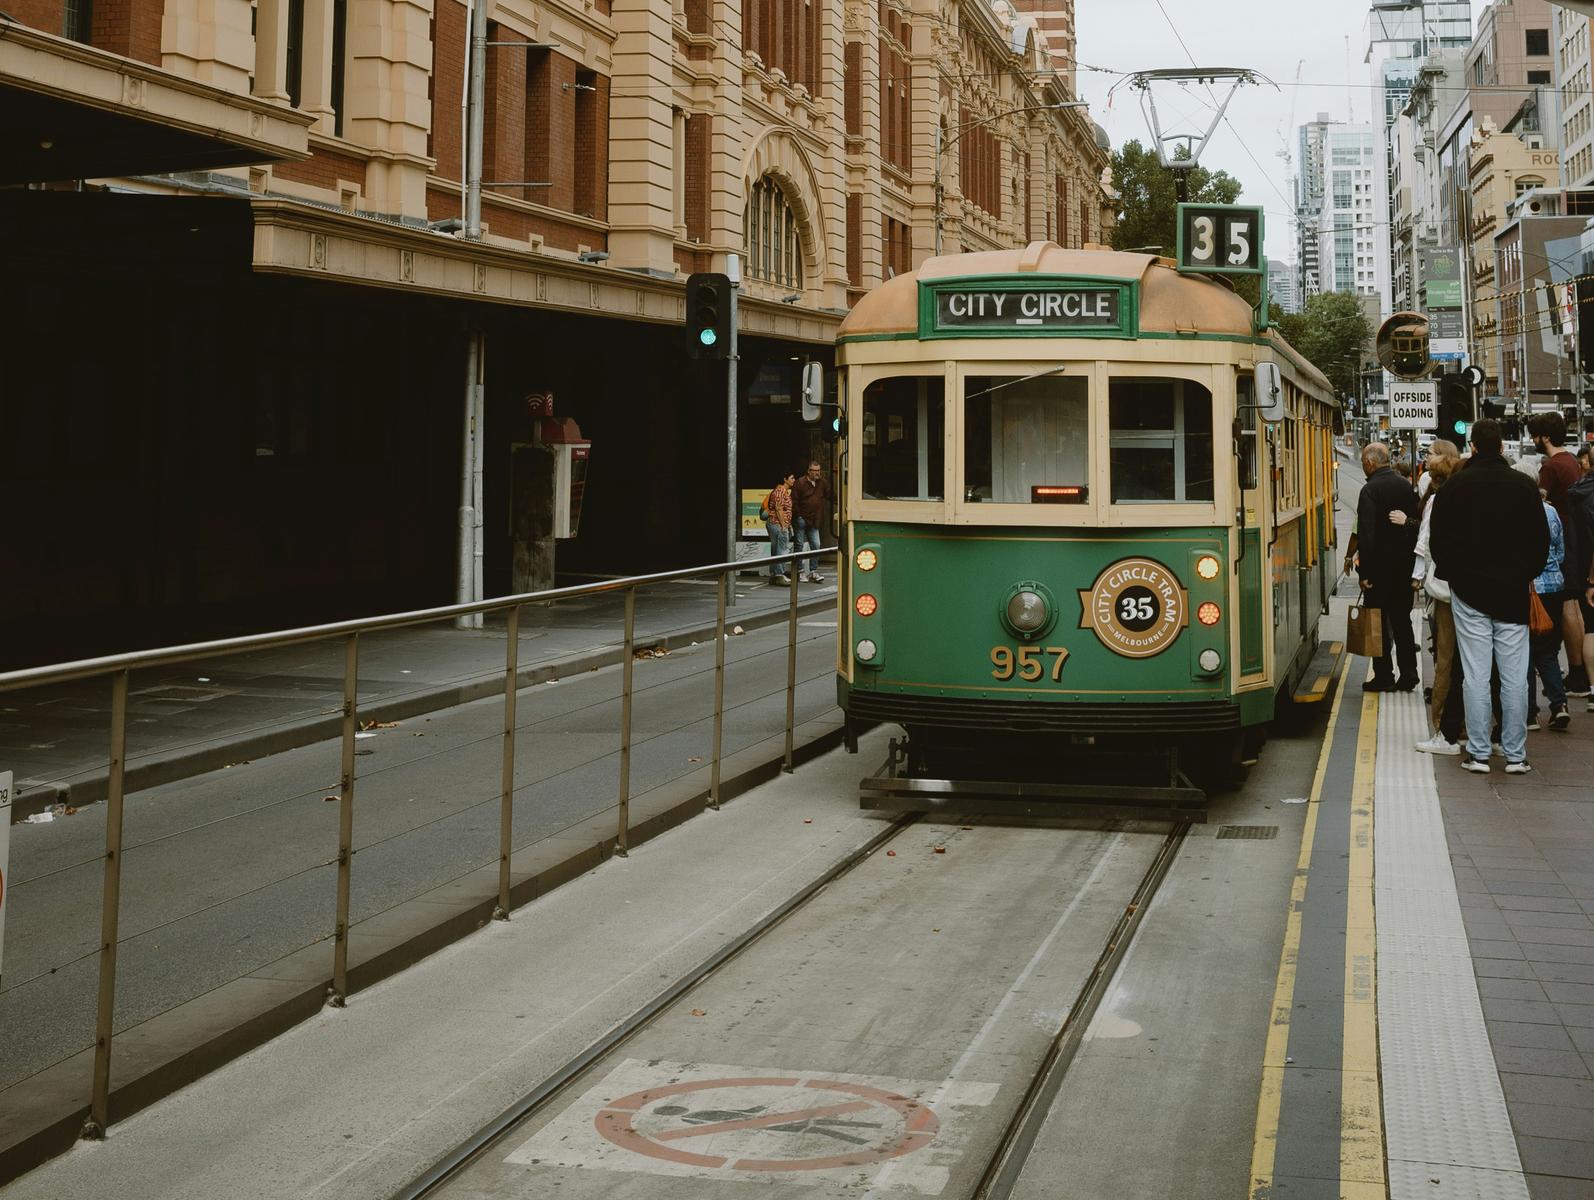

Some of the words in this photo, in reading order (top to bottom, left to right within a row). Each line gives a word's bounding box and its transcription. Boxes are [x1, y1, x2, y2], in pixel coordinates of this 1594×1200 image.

[1191, 216, 1250, 265] 35
[949, 293, 1007, 317] CITY
[1020, 293, 1111, 317] CIRCLE
[1430, 322, 1439, 330] 70
[1394, 392, 1432, 403] OFFSIDE
[1393, 408, 1433, 418] LOADING
[1099, 588, 1112, 624] CITY
[1109, 568, 1158, 589] CIRCLE
[1157, 578, 1177, 623] TRAM
[1121, 596, 1154, 620] 35
[1113, 630, 1163, 647] MELBOURNE
[991, 646, 1070, 682] 957
